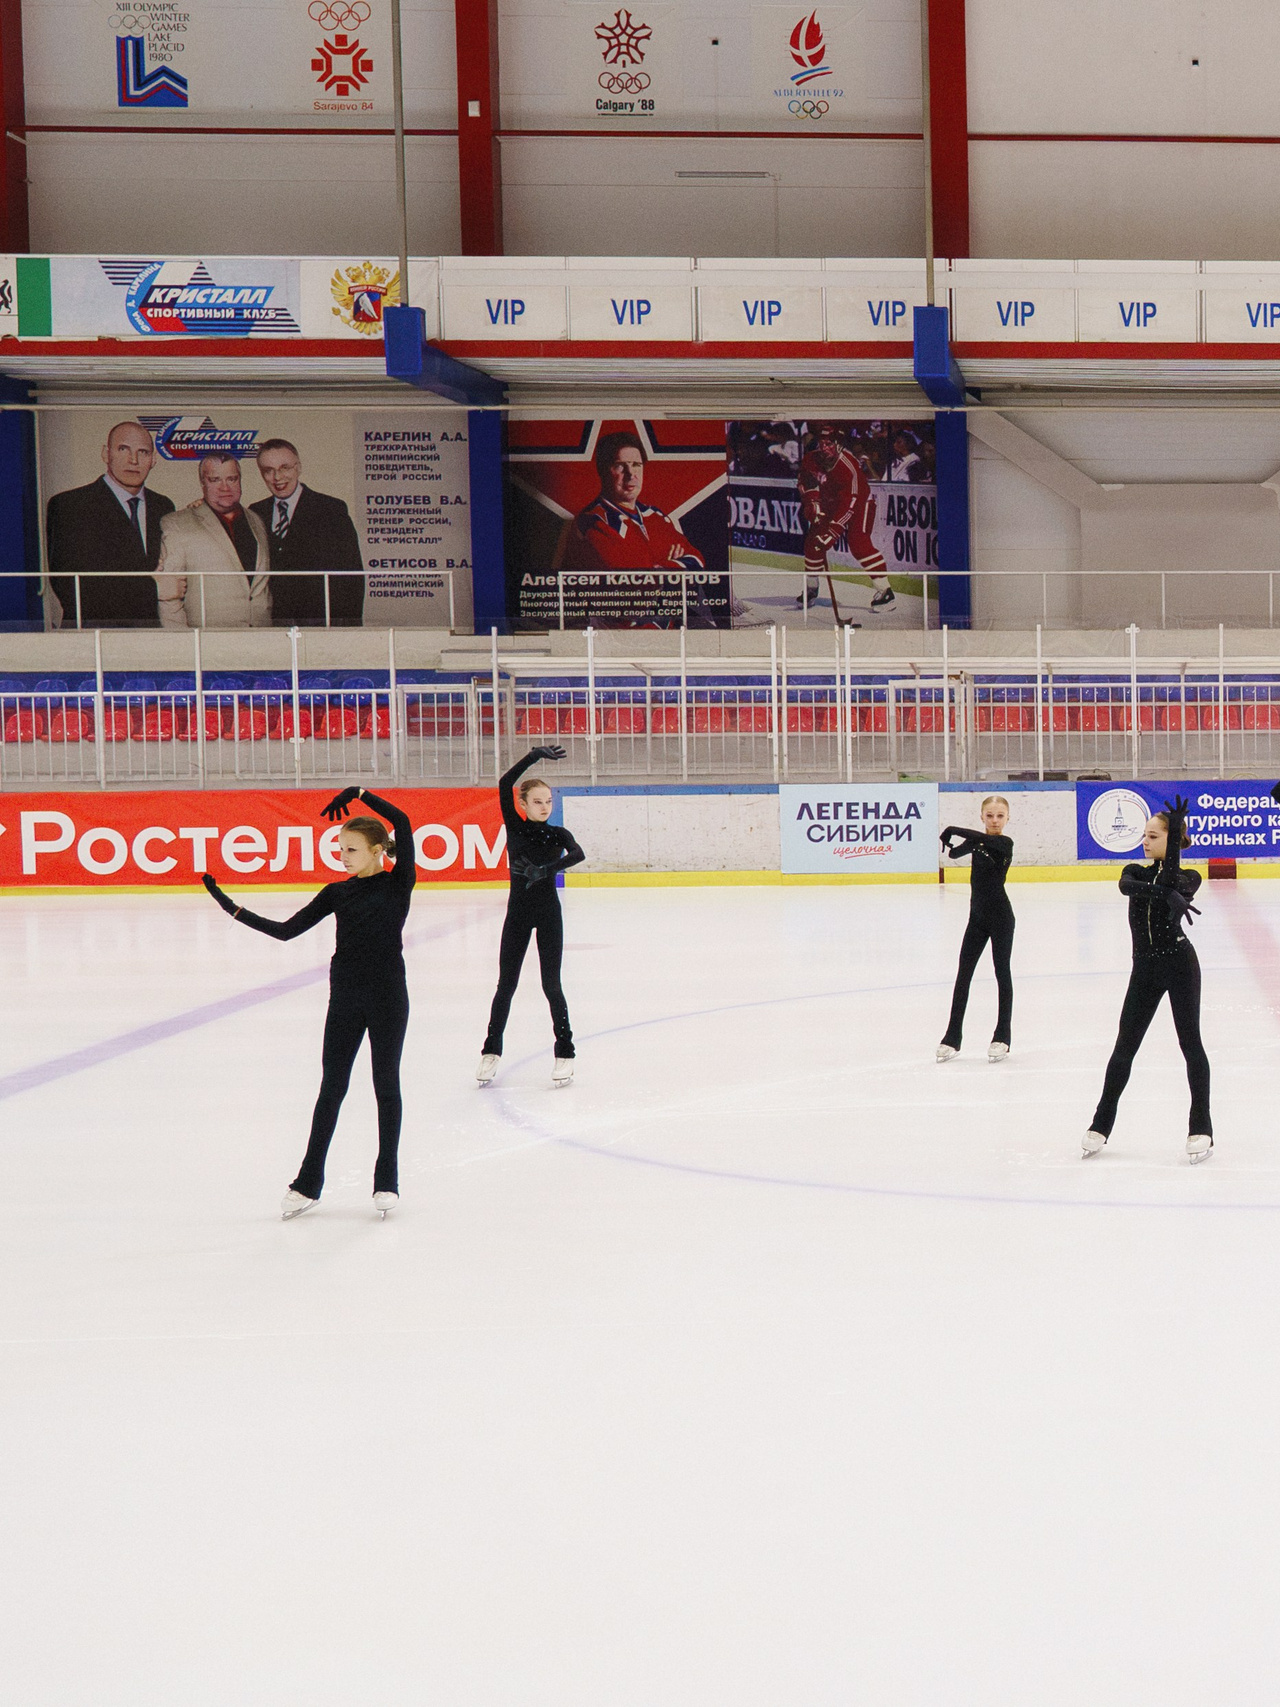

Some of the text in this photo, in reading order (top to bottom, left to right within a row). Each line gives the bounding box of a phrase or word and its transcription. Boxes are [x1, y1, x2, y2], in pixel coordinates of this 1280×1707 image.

[116, 2, 178, 12] XIII OLYMPIC
[150, 12, 190, 22] WINTER
[152, 22, 187, 32] GAMES
[148, 32, 171, 42] LAKE
[148, 42, 184, 52] PLACID
[150, 52, 172, 62] 1980
[313, 101, 358, 112] Sarajevo
[596, 98, 655, 112] Calgary '88
[147, 288, 268, 304] КРИСТАЛЛ
[146, 307, 276, 320] СПОРТИВНЫЙ КЛУБ
[485, 299, 526, 326] VIP
[611, 299, 652, 326] VIP
[742, 300, 782, 326] VIP
[866, 301, 906, 326] VIP
[996, 301, 1035, 327] VIP
[1119, 302, 1158, 328] VIP
[172, 432, 254, 441] КРИСТАЛЛ
[364, 432, 468, 442] КАРЕЛИН А.А.
[170, 442, 231, 450] СПОРТИВНЫЙ
[364, 442, 436, 451] ТРЕХКРАТНЫЙ
[364, 452, 440, 461] ОЛИМПИЙСКИЙ
[364, 464, 433, 472] ПОБЕДИТЕЛЬ,
[366, 472, 397, 480] ГЕРОЙ
[366, 494, 467, 505] ГОЛУБЕВ В.А.
[366, 507, 442, 515] ЗАСЛУЖЕННЫЙ
[886, 494, 936, 530] ABSOL
[409, 518, 452, 526] РОССИИ,
[894, 530, 918, 563] ON
[368, 558, 472, 568] ФЕТИСОВ В.А.
[369, 580, 444, 588] ОЛИМПИЙСКИЙ
[606, 574, 721, 585] КАСАТОНОВ
[370, 590, 434, 598] ПОБЕДИТЕЛЬ
[579, 589, 642, 598] олимпийский
[644, 590, 698, 598] победитль
[634, 600, 660, 608] мира,
[702, 598, 728, 606] СССР
[658, 608, 683, 616] СССР
[796, 802, 922, 820] ЛЕГЕНДА
[1187, 816, 1263, 831] игурного
[806, 824, 912, 842] СИБИРИ
[20, 811, 510, 876] Ростелом
[1191, 834, 1266, 846] коньках
[833, 844, 892, 857] щелочная
